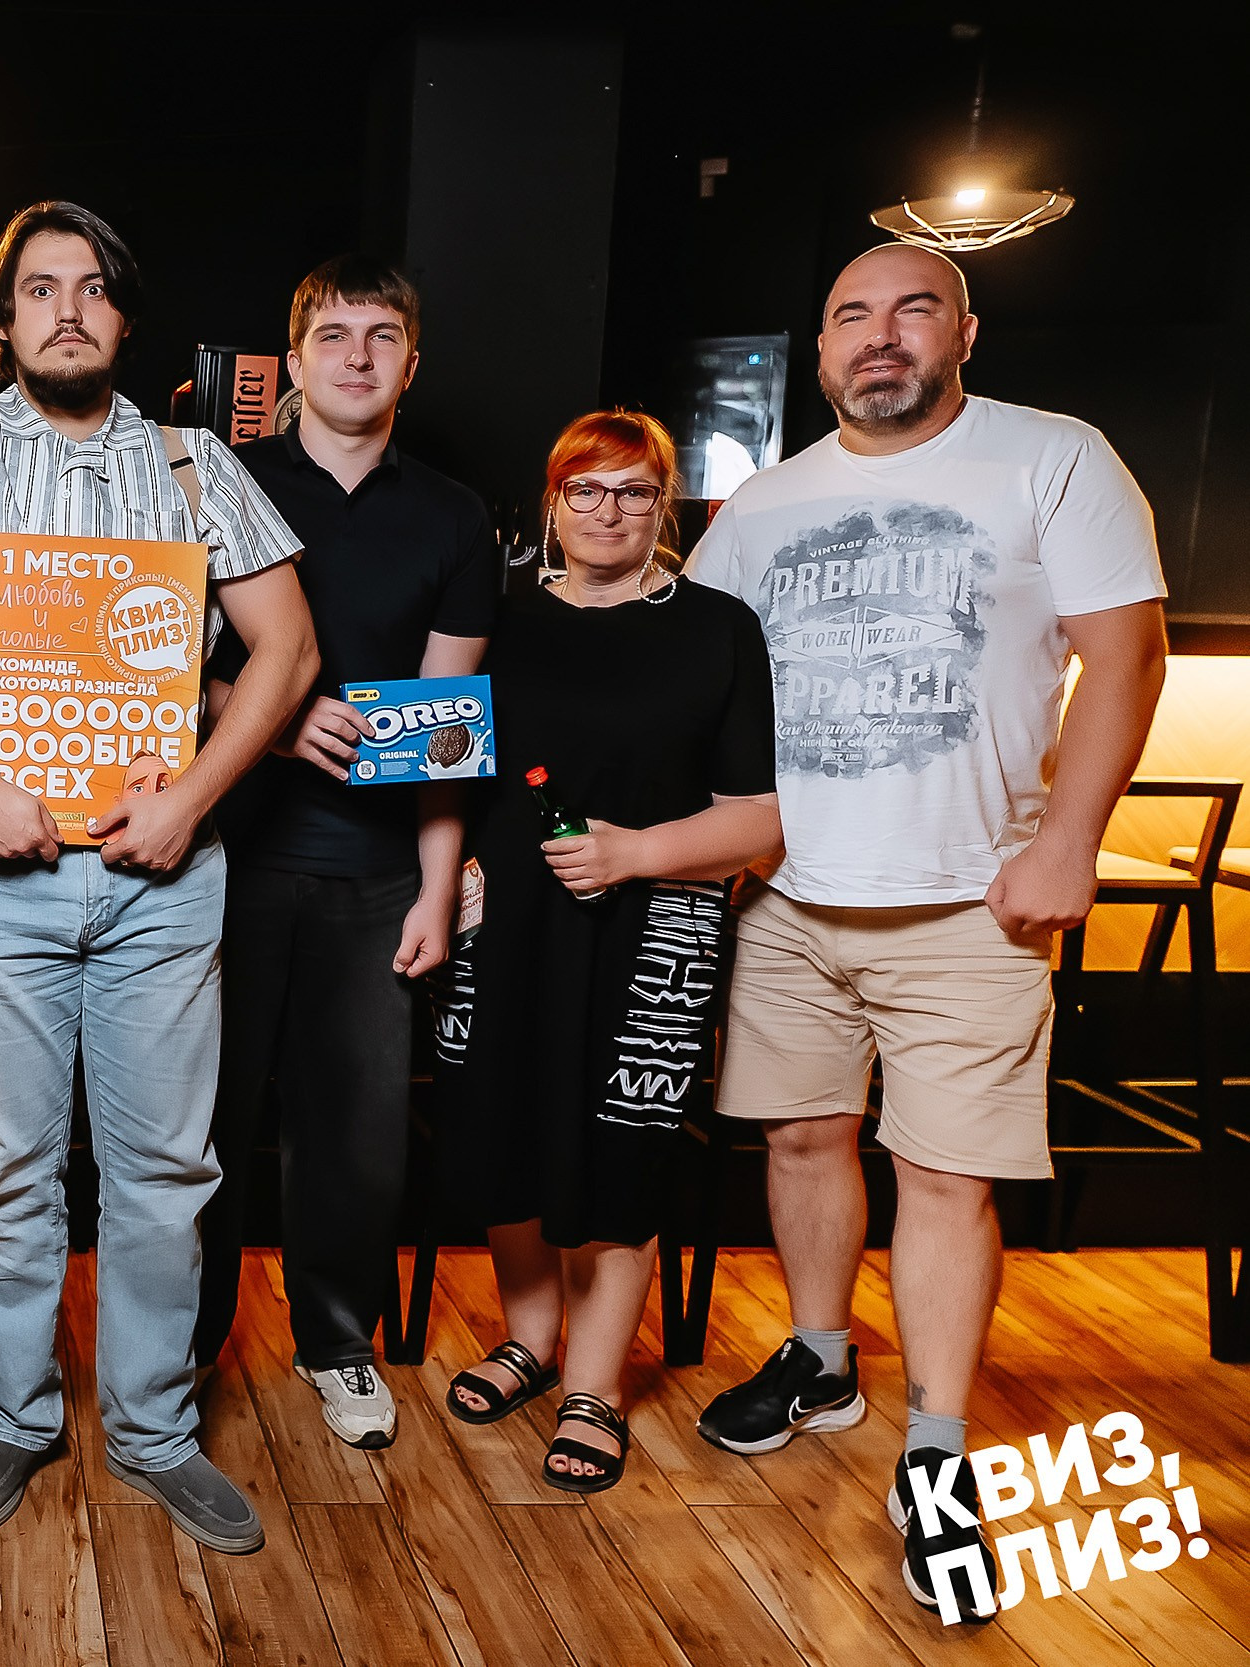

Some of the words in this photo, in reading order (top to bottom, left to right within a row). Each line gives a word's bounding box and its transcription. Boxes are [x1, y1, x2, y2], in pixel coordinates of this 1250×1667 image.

[809, 540, 863, 558] VINTAGE
[1, 549, 14, 575] 1
[23, 550, 134, 581] МЕСТО
[106, 592, 115, 602] И
[766, 548, 973, 627] PREMIUM
[801, 630, 851, 649] WORK
[867, 626, 922, 645] WEAR
[74, 679, 159, 697] РАЗНЕСЛА
[366, 697, 481, 740] OREO
[379, 750, 419, 760] ORIGINAL
